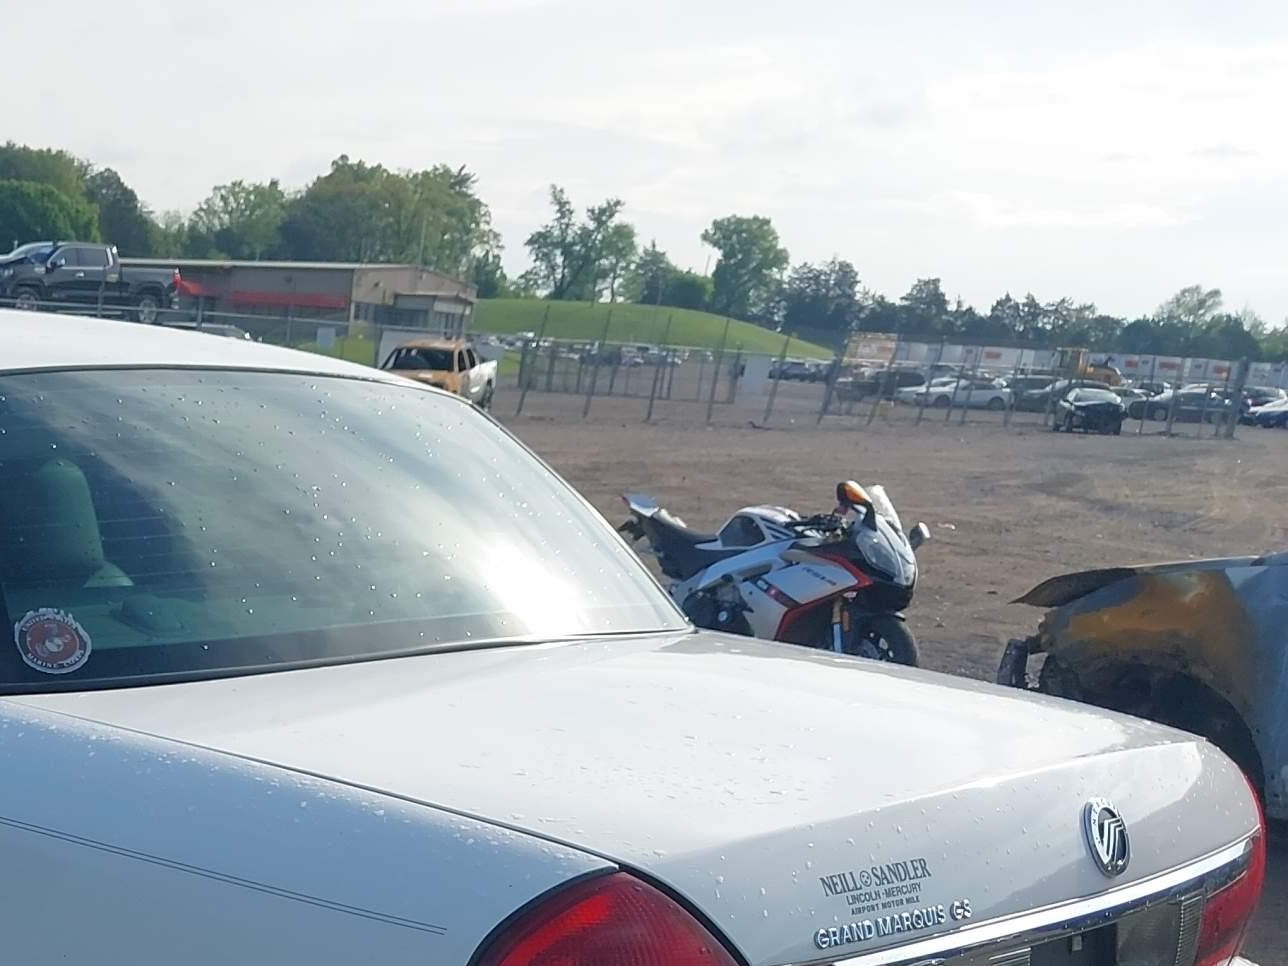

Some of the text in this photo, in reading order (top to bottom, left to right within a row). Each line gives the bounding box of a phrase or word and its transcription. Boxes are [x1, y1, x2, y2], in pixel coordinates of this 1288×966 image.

[820, 857, 932, 897] NEILL SANDLER
[846, 891, 882, 906] LINCOLN
[851, 895, 921, 916] AIRPORT MOTOR MILE
[815, 898, 973, 949] GRAND MARQUIS GS
